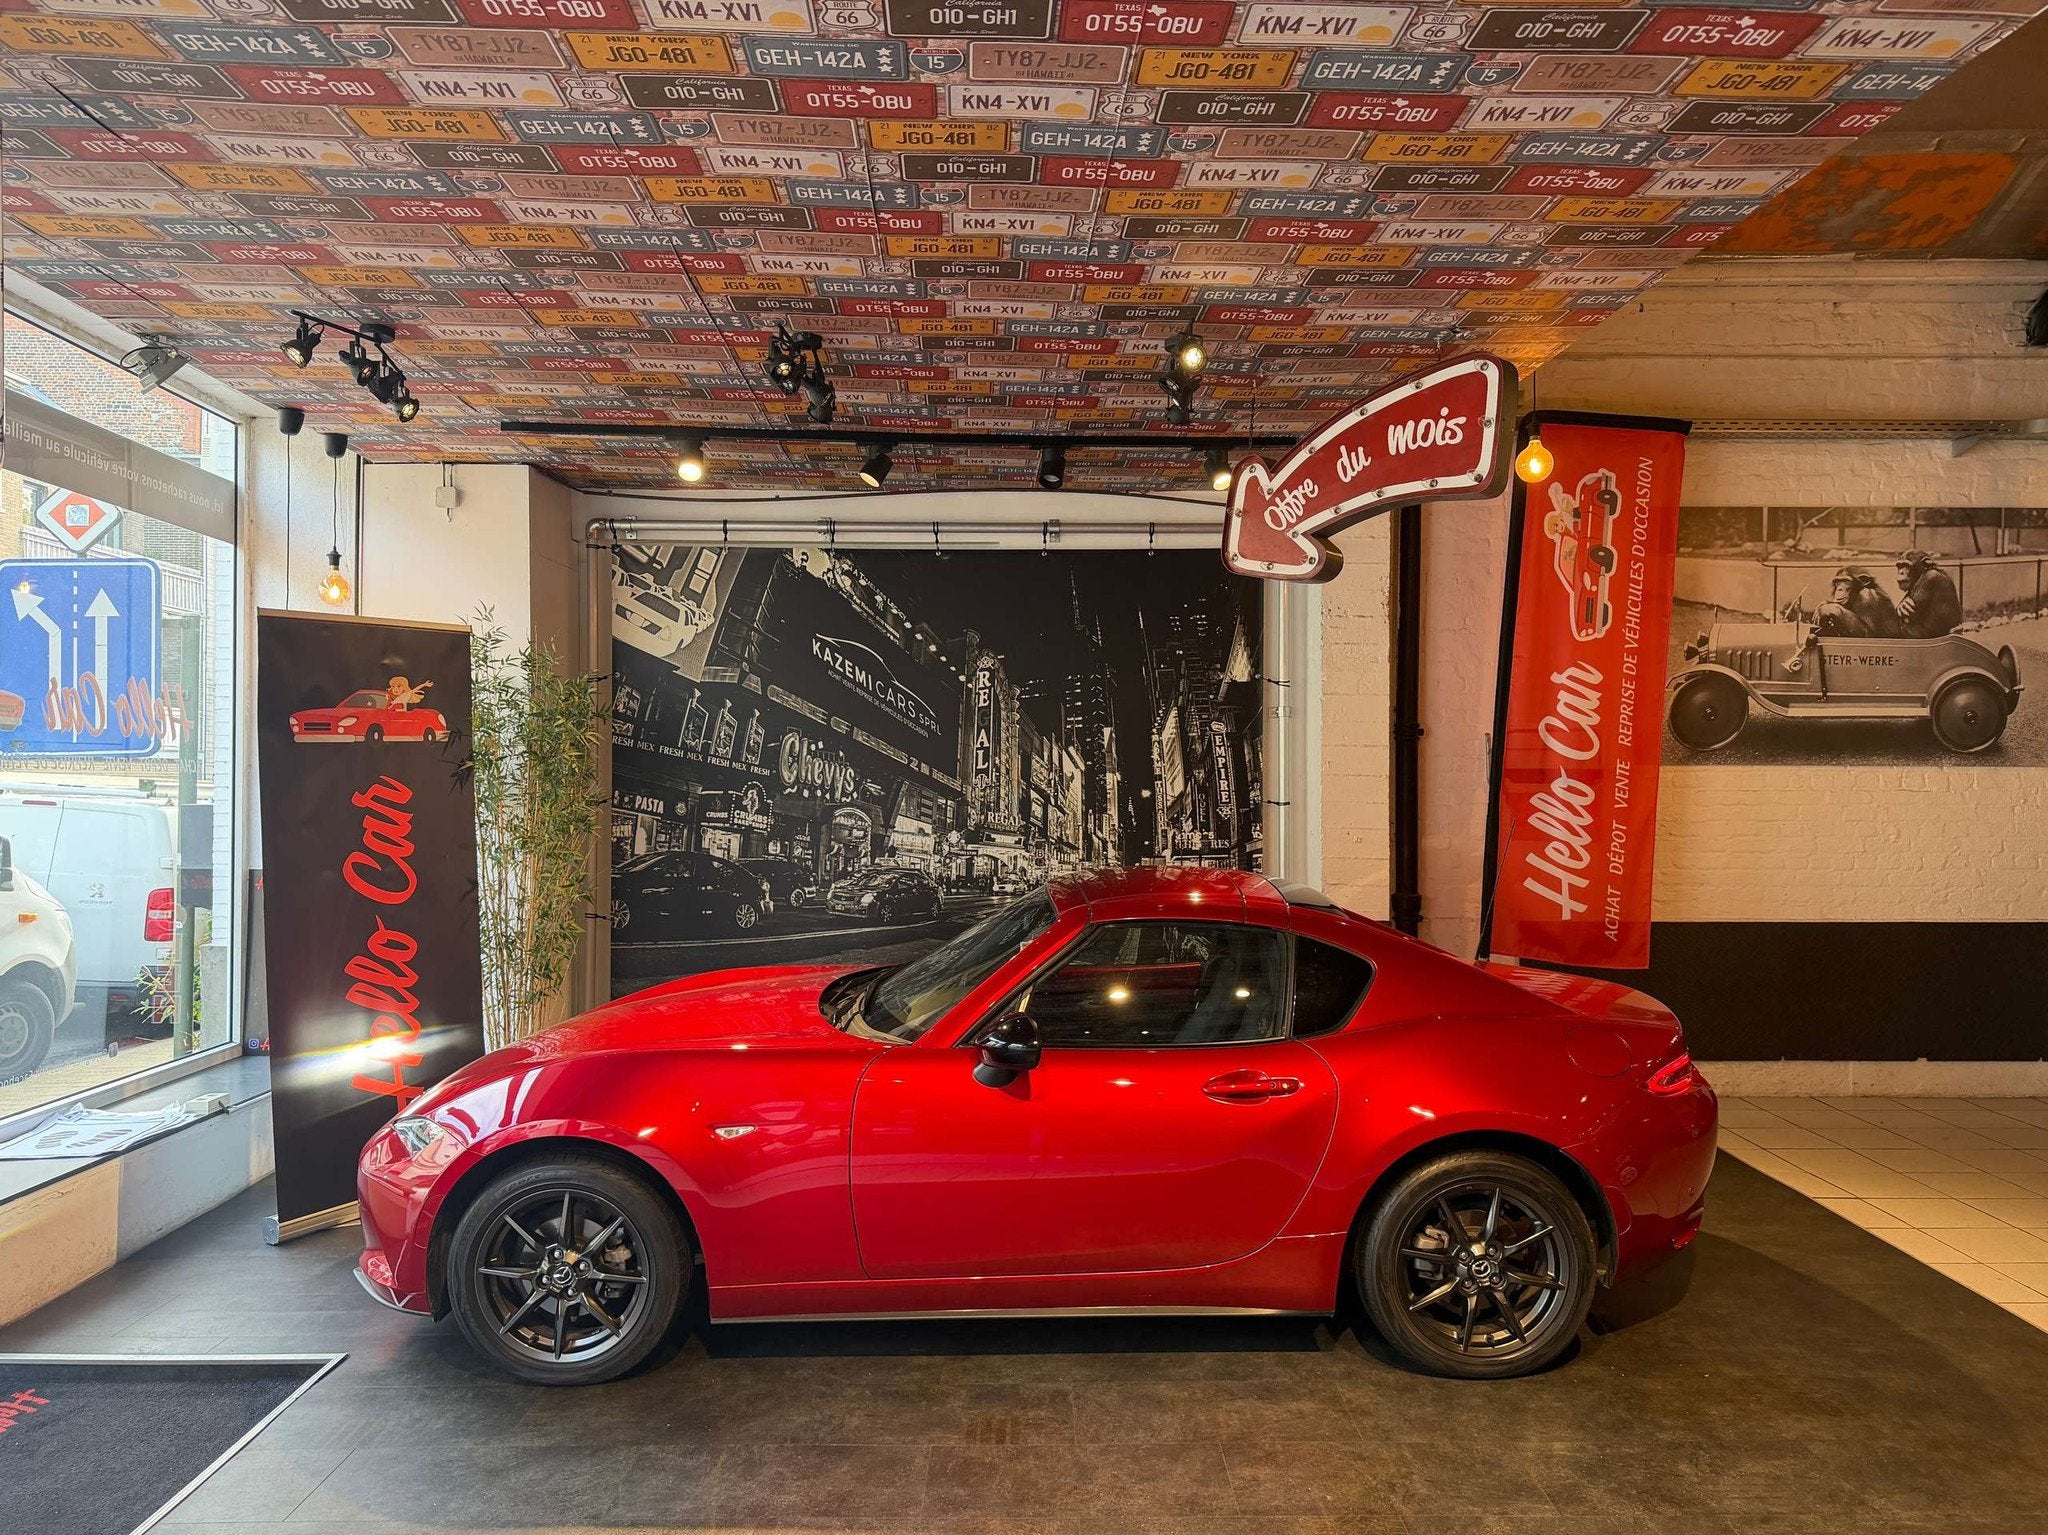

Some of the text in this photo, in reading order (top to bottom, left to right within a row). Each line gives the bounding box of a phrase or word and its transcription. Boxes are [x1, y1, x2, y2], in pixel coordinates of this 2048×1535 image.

[660, 0, 763, 22] KN4-XV1
[1112, 3, 1141, 12] TEXAS
[833, 10, 859, 25] 66
[1700, 16, 1735, 25] TEXAS
[1252, 16, 1359, 37] KN4-XV1
[1420, 24, 1451, 38] 66
[169, 34, 299, 54] GEH-142A
[578, 35, 594, 43] 21
[604, 35, 641, 43] NEW
[1821, 29, 1939, 49] KN4-XV1
[349, 41, 380, 54] 15
[753, 48, 867, 68] GEH-142A
[926, 56, 946, 69] 15
[1311, 62, 1427, 81] GEH-142A
[1475, 69, 1504, 81] 15
[416, 81, 519, 98] KN4-XV1
[674, 77, 728, 86] California
[577, 88, 605, 100] 66
[961, 94, 1052, 111] KN4-XV1
[1113, 103, 1136, 114] 66
[1478, 107, 1577, 123] KN4-XV1
[517, 119, 625, 135] GEH-142A
[1029, 132, 1129, 148] GEH-142A
[226, 142, 322, 161] KN4-XV1
[1518, 141, 1626, 156] GEH-142A
[718, 156, 804, 170] KN4-XV1
[323, 176, 425, 190] GEH-142A
[1196, 169, 1282, 182] KN4-XV1
[1659, 176, 1752, 189] KN4-XV1
[794, 187, 886, 201] GEH-142A
[61, 197, 154, 209] KN4-XV1
[1246, 198, 1340, 211] GEH-142A
[517, 208, 600, 220] KN4-XV1
[962, 218, 1036, 230] KN4-XV1
[1264, 407, 1467, 531] Offre du mois
[1622, 562, 1644, 649] VÉHICULES
[1622, 654, 1637, 675] DE
[812, 638, 873, 691] KAZEMI
[875, 681, 916, 718] CARS
[919, 713, 942, 736] SPRL
[1538, 660, 1604, 760] Car
[1618, 676, 1636, 747] REPRISE
[975, 671, 992, 770] REGAL
[636, 739, 655, 752] MEX
[659, 745, 684, 759] FRESH
[686, 750, 704, 762] MEX
[707, 755, 730, 768] FRESH
[732, 761, 747, 771] MEX
[750, 766, 771, 776] FRESH
[779, 732, 857, 801] Chevys
[1214, 735, 1231, 804] EMPIRE
[1614, 761, 1631, 809] VENTE
[635, 795, 664, 814] PASTA
[706, 811, 729, 819] CRUMBS
[734, 810, 769, 825] CRUMBS
[1523, 765, 1596, 920] Hello
[1609, 820, 1627, 875] DÉPOT
[1604, 886, 1621, 942] ACHAT
[342, 775, 424, 1115] Hello Car
